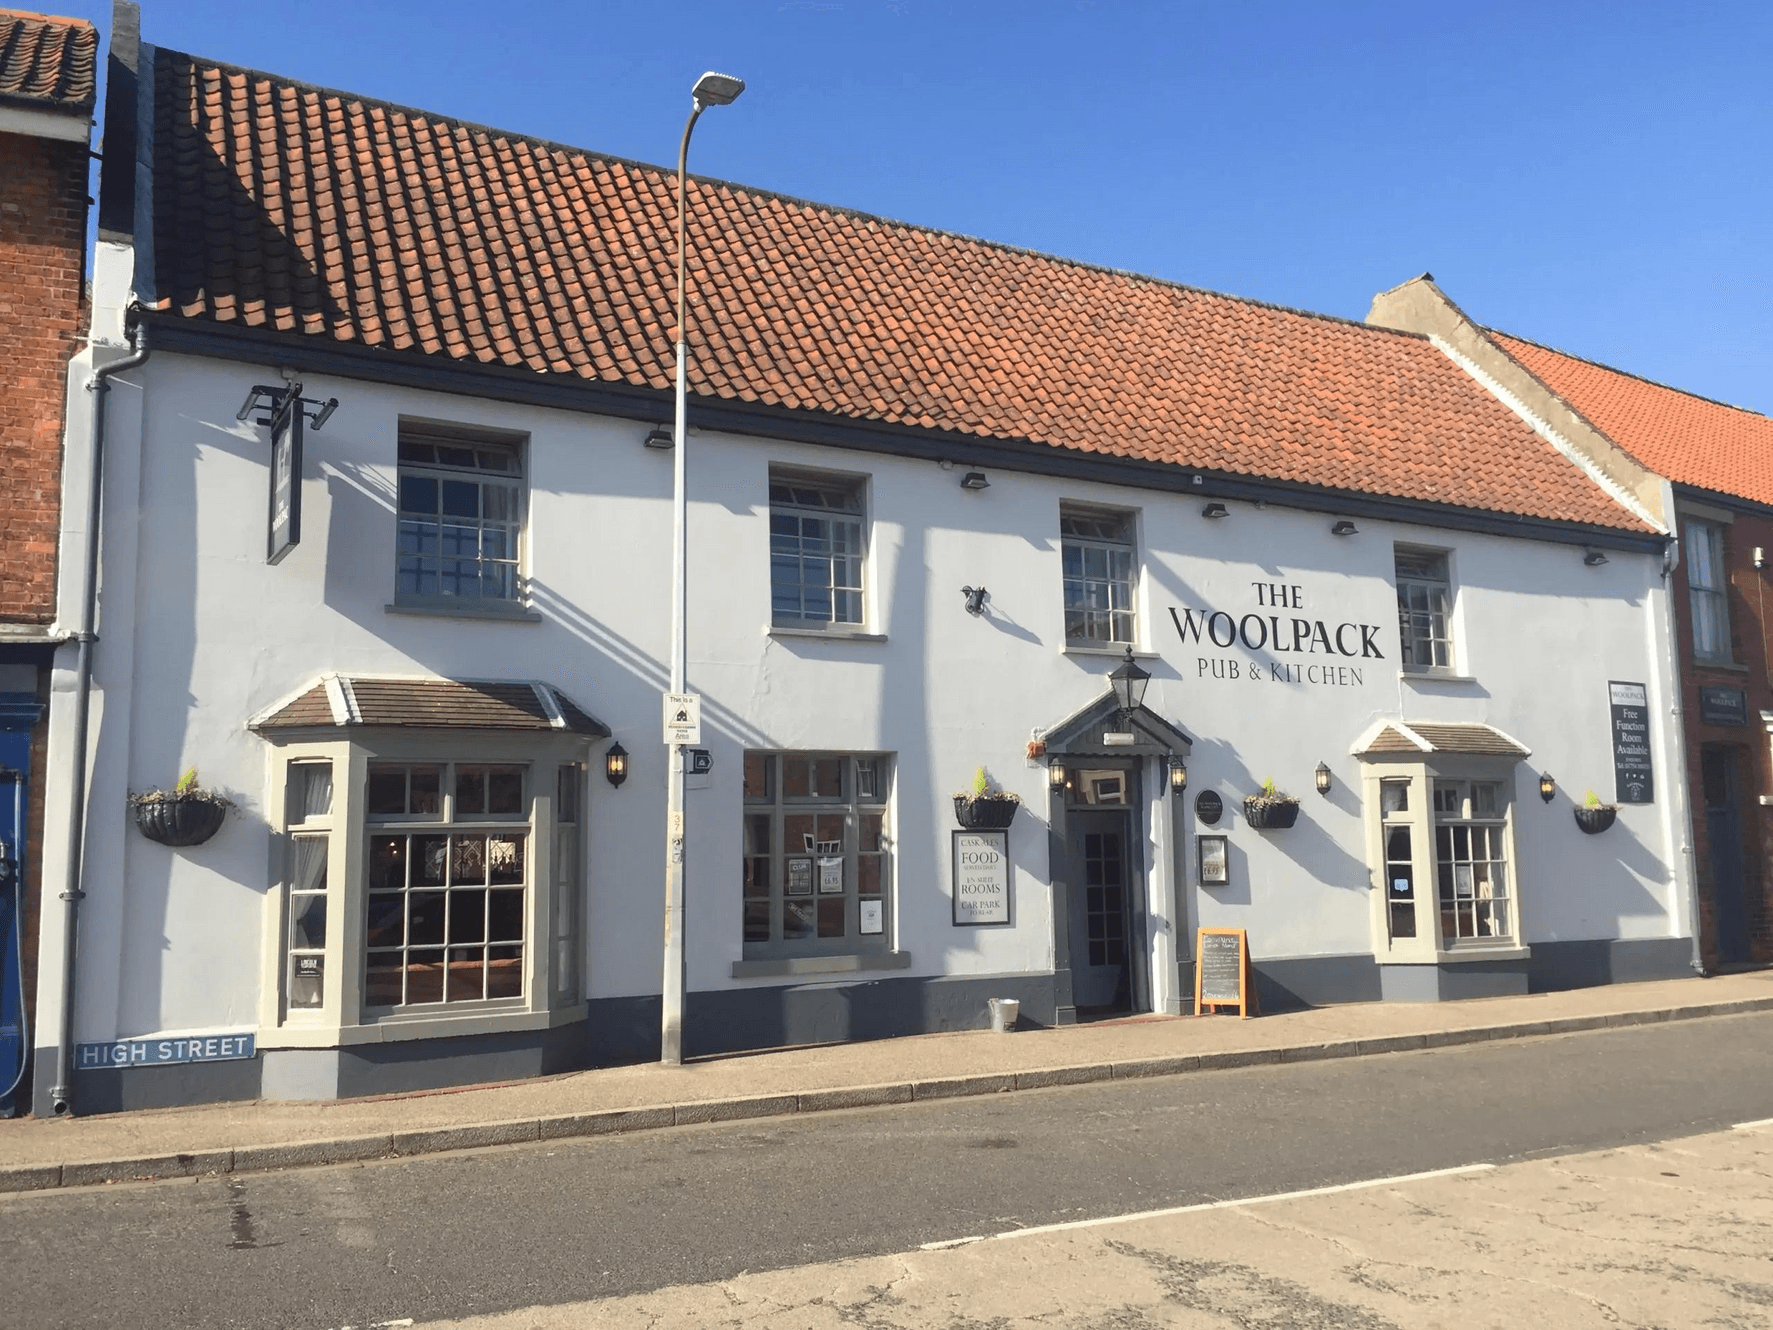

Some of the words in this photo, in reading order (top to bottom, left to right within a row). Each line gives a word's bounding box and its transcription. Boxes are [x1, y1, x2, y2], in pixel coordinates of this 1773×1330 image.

[1251, 582, 1303, 609] THE
[1168, 607, 1385, 659] WOOLPACK
[1197, 658, 1240, 680] PUB
[1249, 661, 1262, 681] &
[1270, 662, 1364, 687] KITCHEN
[1623, 708, 1638, 719] Free
[1616, 720, 1645, 731] Function
[1622, 732, 1642, 743] Room
[1617, 744, 1648, 755] Available
[961, 839, 980, 847] CASK
[962, 851, 999, 864] FOOD
[961, 884, 1001, 894] ROOMS
[961, 901, 978, 909] CAR
[979, 900, 1000, 908] PARK
[83, 1043, 146, 1064] HIGH
[158, 1037, 248, 1060] STREET
